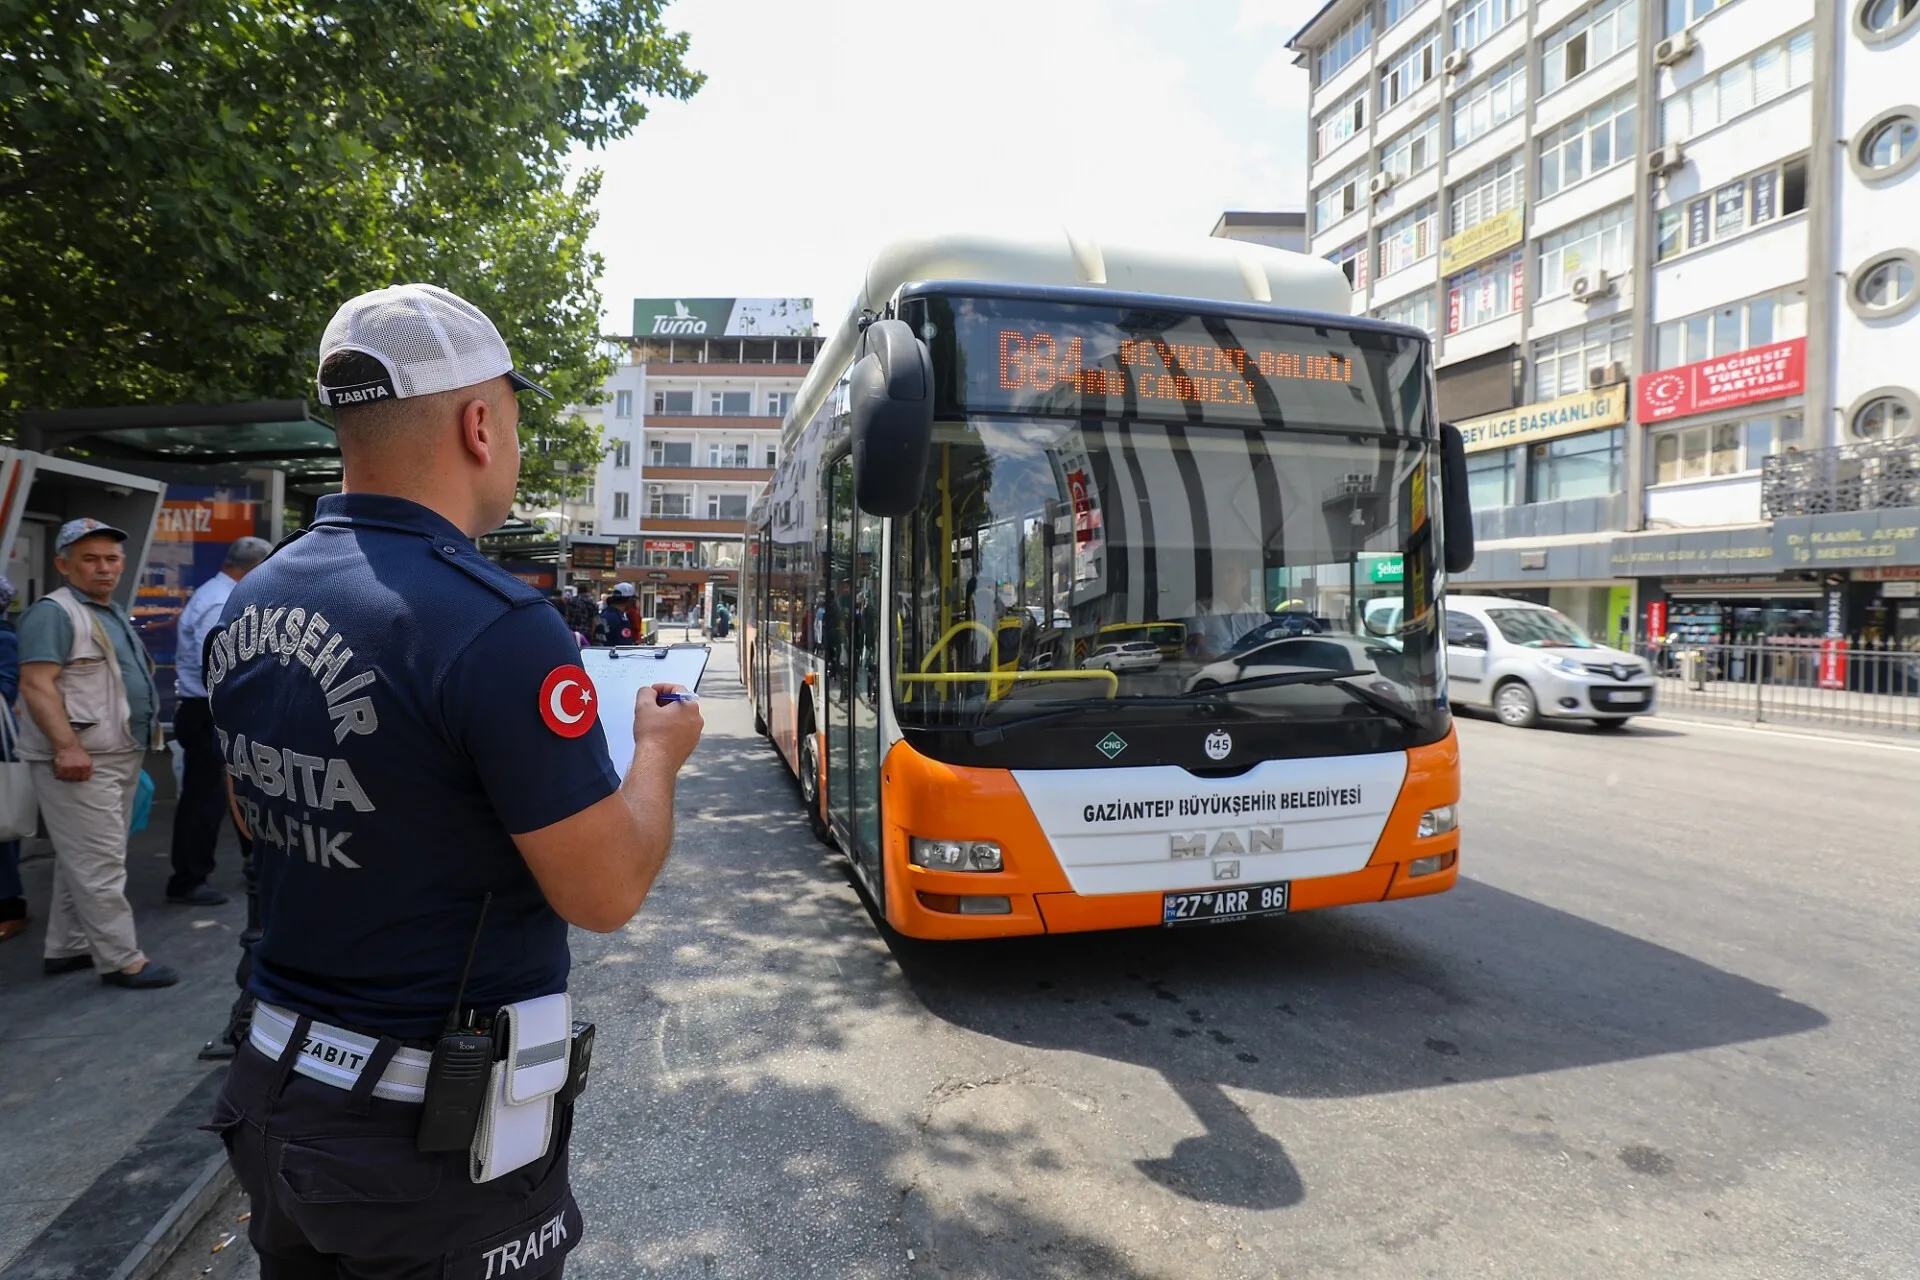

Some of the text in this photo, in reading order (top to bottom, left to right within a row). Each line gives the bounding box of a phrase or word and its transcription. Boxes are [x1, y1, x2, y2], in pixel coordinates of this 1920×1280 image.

[651, 315, 707, 334] Turna
[1000, 330, 1084, 393] B84
[1709, 371, 1784, 394] PARTİSİ
[335, 385, 389, 404] ZABITA
[1488, 418, 1516, 440] İLÇE
[1102, 740, 1121, 750] CNG
[1207, 739, 1229, 750] 145
[1083, 784, 1362, 822] GAZİANTEP BÜYÜKŞEHİR BELEDİYESİ
[1170, 827, 1285, 859] MAN
[1176, 895, 1201, 917] 27
[1213, 890, 1249, 914] ARR
[1261, 886, 1284, 908] 86
[300, 1038, 364, 1073] ZABIT
